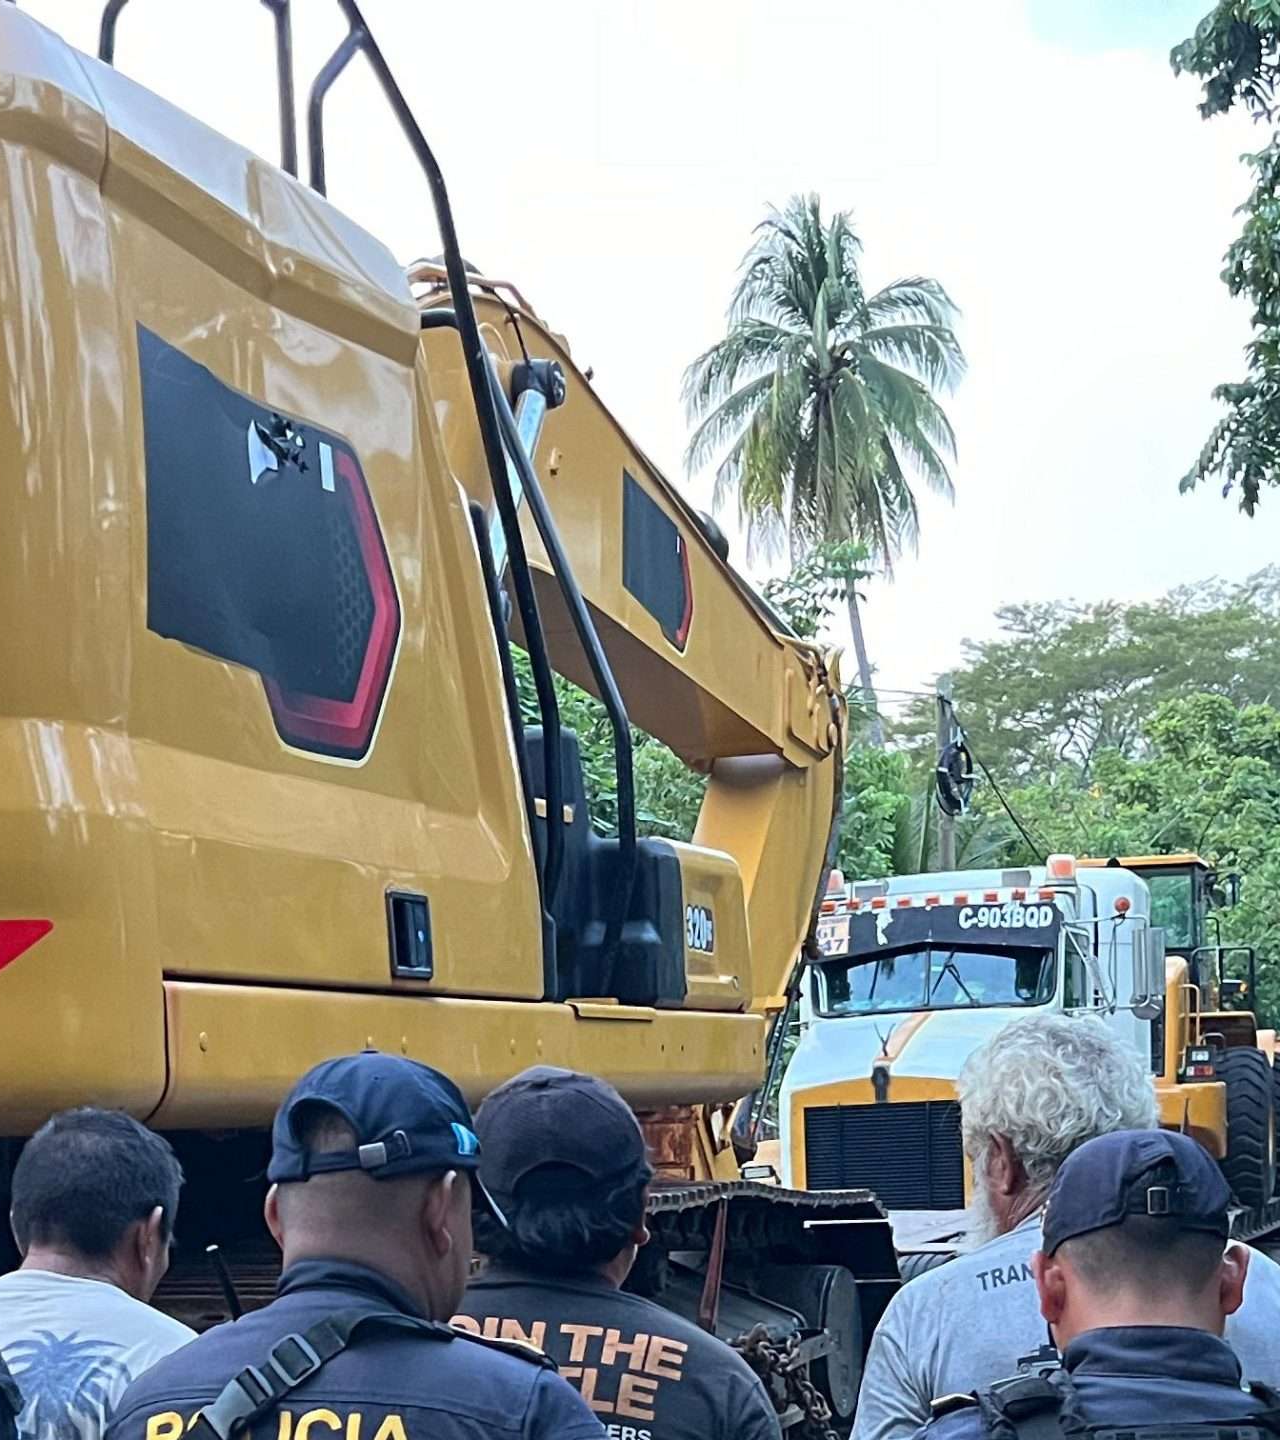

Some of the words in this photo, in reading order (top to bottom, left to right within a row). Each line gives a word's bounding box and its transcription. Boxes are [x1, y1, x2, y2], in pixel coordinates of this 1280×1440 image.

[686, 905, 707, 950] 320
[958, 905, 1054, 930] C-903BQD
[976, 1264, 1035, 1291] TRAN
[559, 1323, 688, 1381] THE
